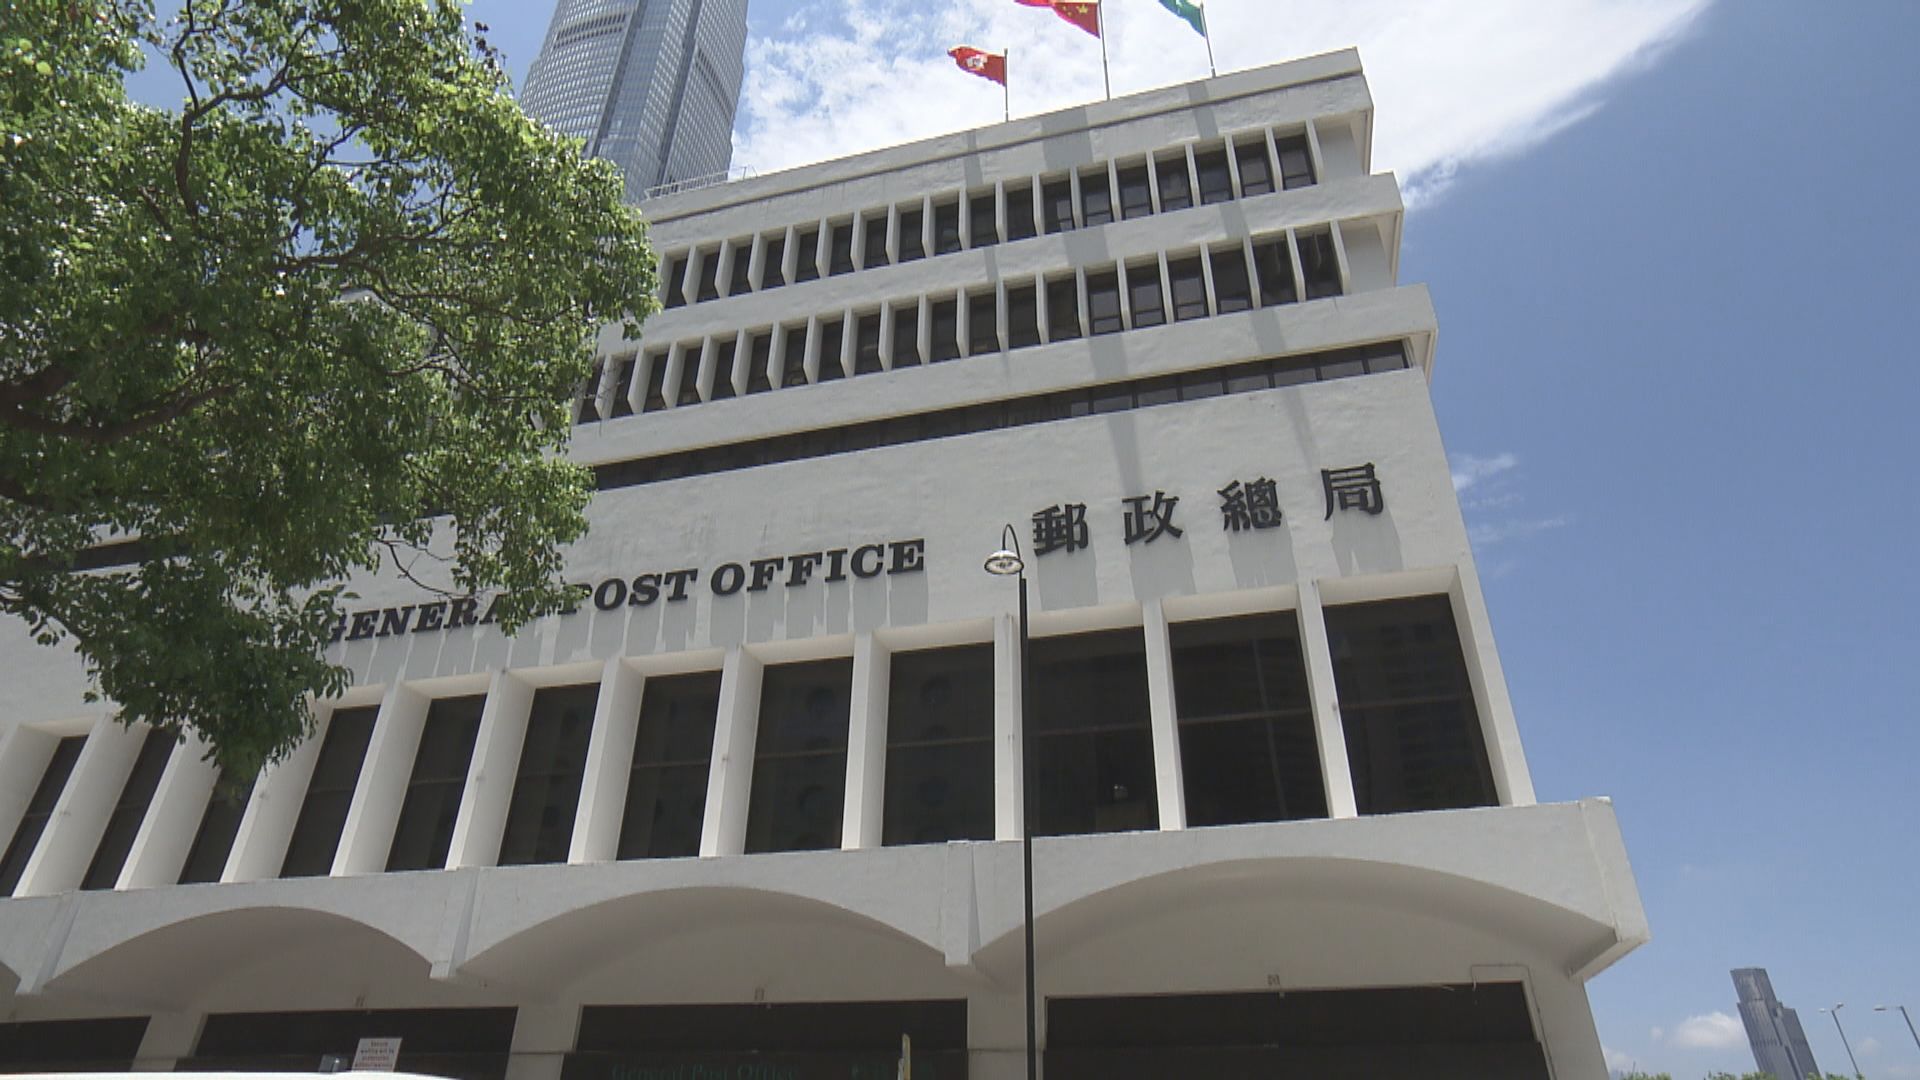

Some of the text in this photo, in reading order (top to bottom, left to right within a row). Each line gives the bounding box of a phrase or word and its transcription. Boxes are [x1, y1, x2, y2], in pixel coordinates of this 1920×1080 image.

[1031, 462, 1384, 557] 郵政總局
[318, 588, 546, 643] ENERA
[709, 538, 926, 597] OFFICE
